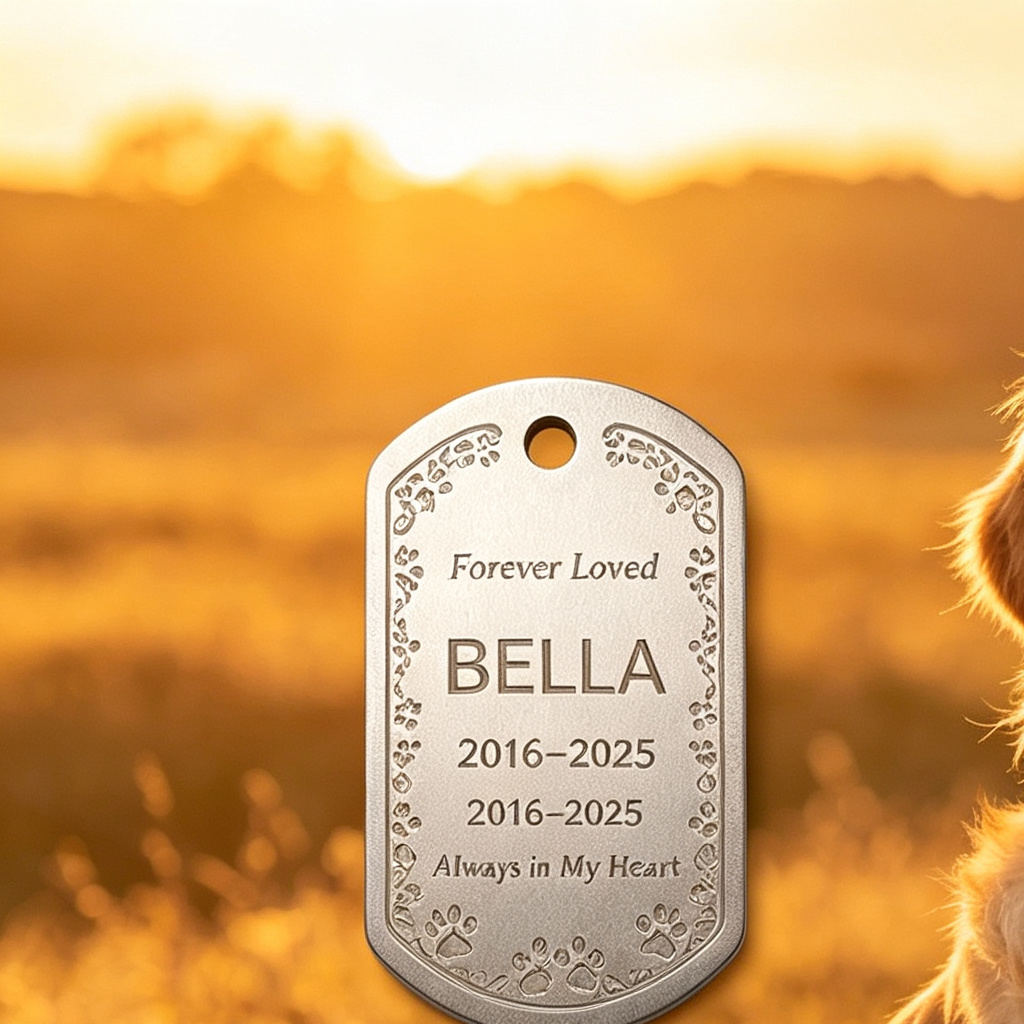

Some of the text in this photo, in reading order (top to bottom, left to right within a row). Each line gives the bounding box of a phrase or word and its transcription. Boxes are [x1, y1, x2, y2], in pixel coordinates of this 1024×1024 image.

[449, 552, 660, 581] Forever Loved
[447, 638, 667, 695] BELLA
[457, 738, 656, 769] 2016–2025
[466, 798, 644, 827] 2016–2025
[432, 854, 682, 884] Always in My Heart
